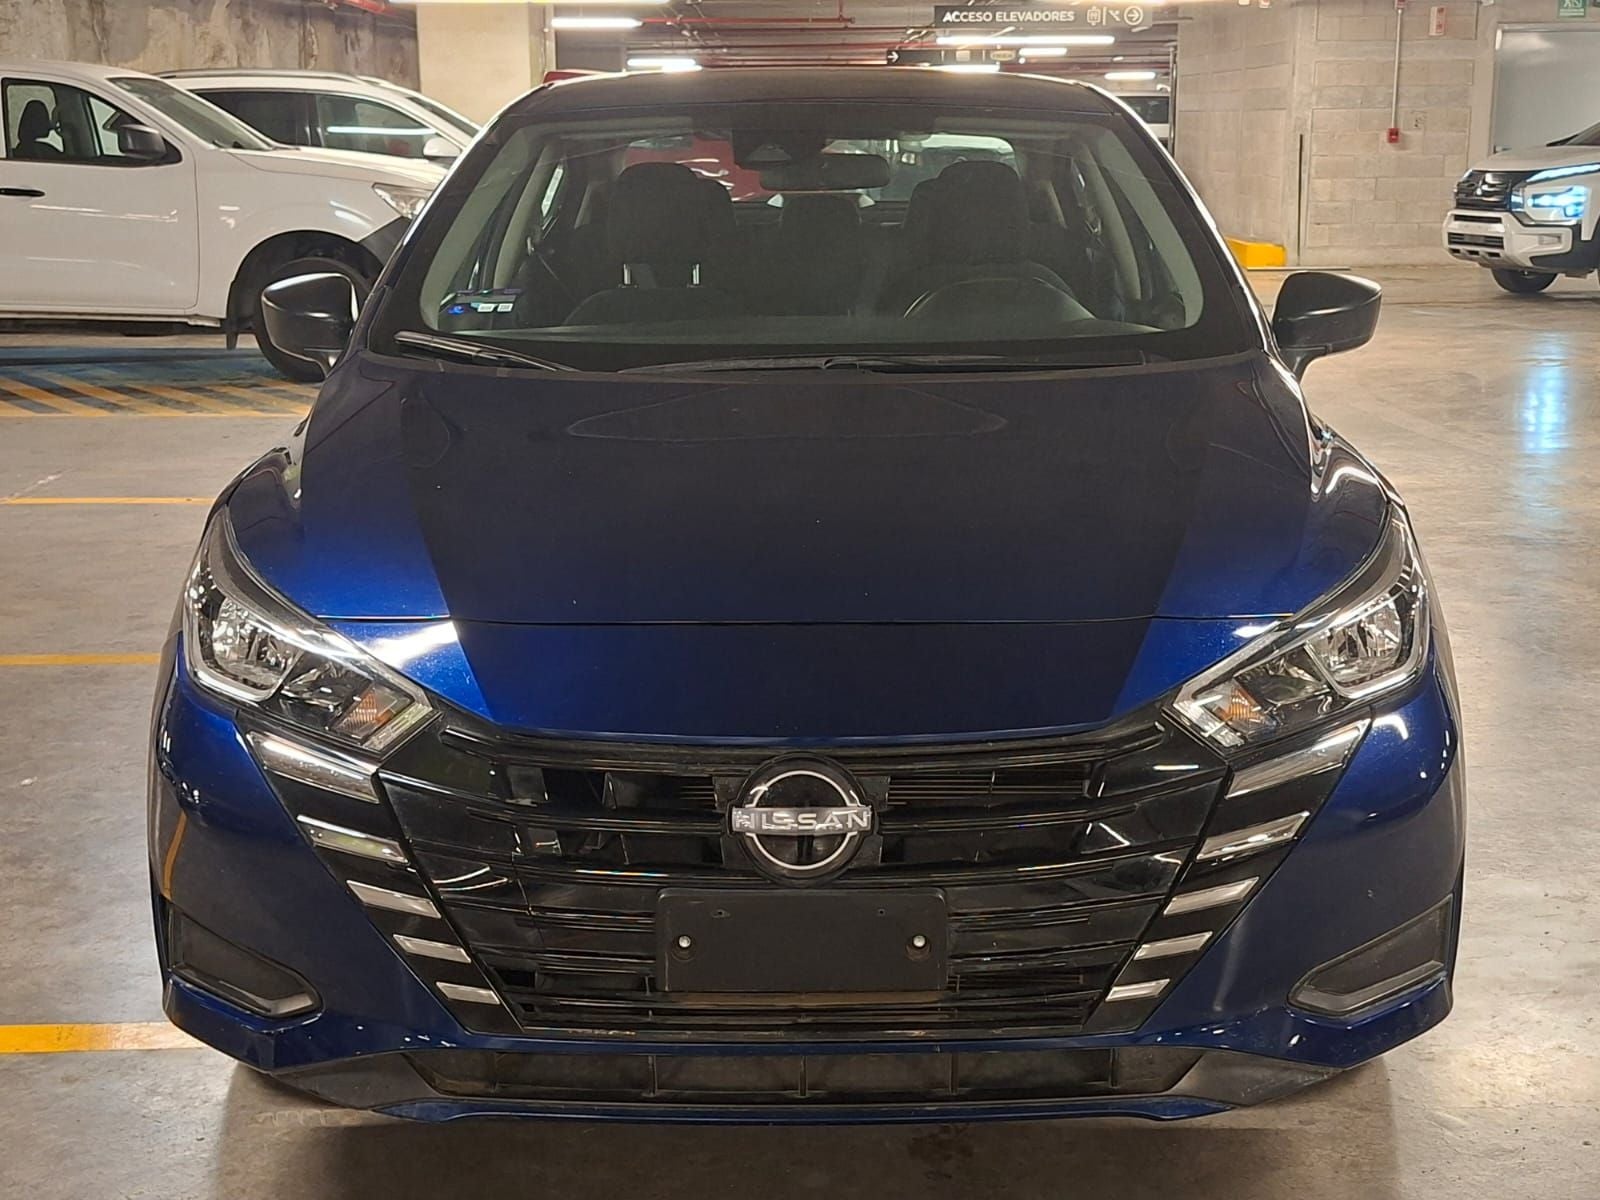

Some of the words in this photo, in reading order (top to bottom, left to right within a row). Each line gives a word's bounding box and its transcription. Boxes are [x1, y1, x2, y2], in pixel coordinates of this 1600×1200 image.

[942, 11, 993, 22] ACCESO
[995, 11, 1075, 22] ELEVADORES
[734, 810, 869, 830] NISSAN
